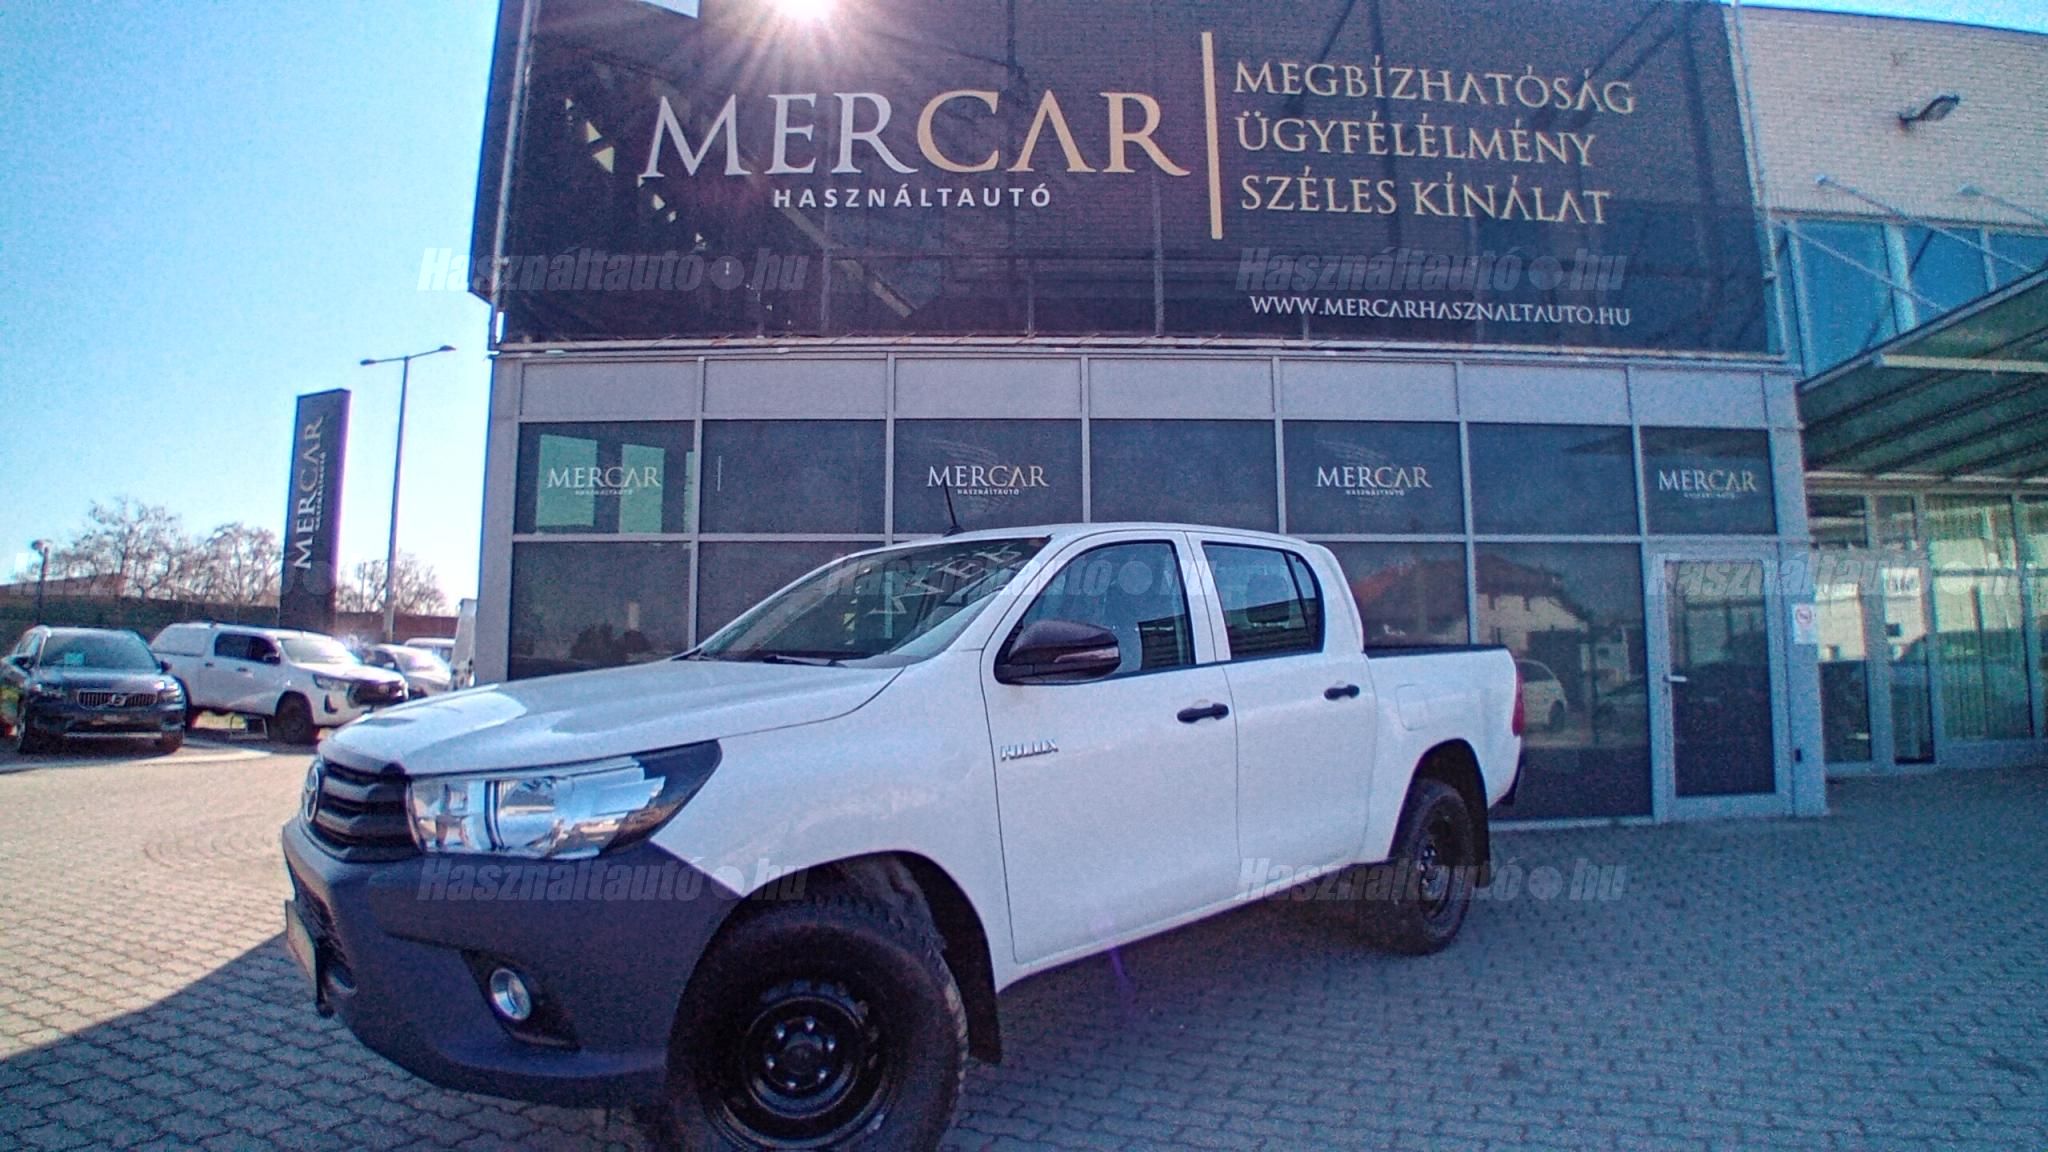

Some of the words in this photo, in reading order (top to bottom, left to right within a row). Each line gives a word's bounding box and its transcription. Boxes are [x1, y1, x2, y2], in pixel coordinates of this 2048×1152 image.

[1233, 55, 1635, 114] MEGBÍZHATÓSÁG
[640, 89, 1191, 178] MERCAR
[1234, 111, 1596, 167] ÜGYFÉLÉLMÉNY
[773, 183, 1052, 209] HASZNÁLTAUTÓ
[1241, 166, 1396, 215] SZÉLES
[1411, 172, 1611, 225] KÍNÁLAT
[1250, 295, 1632, 327] WWW.MERCARHASZNALTAUTO.HU
[547, 466, 662, 489] MERCAR
[926, 465, 1050, 488] MERCAR
[1315, 466, 1433, 489] MERCAR
[1658, 469, 1758, 493] MERCAR
[294, 416, 324, 570] MERCAR
